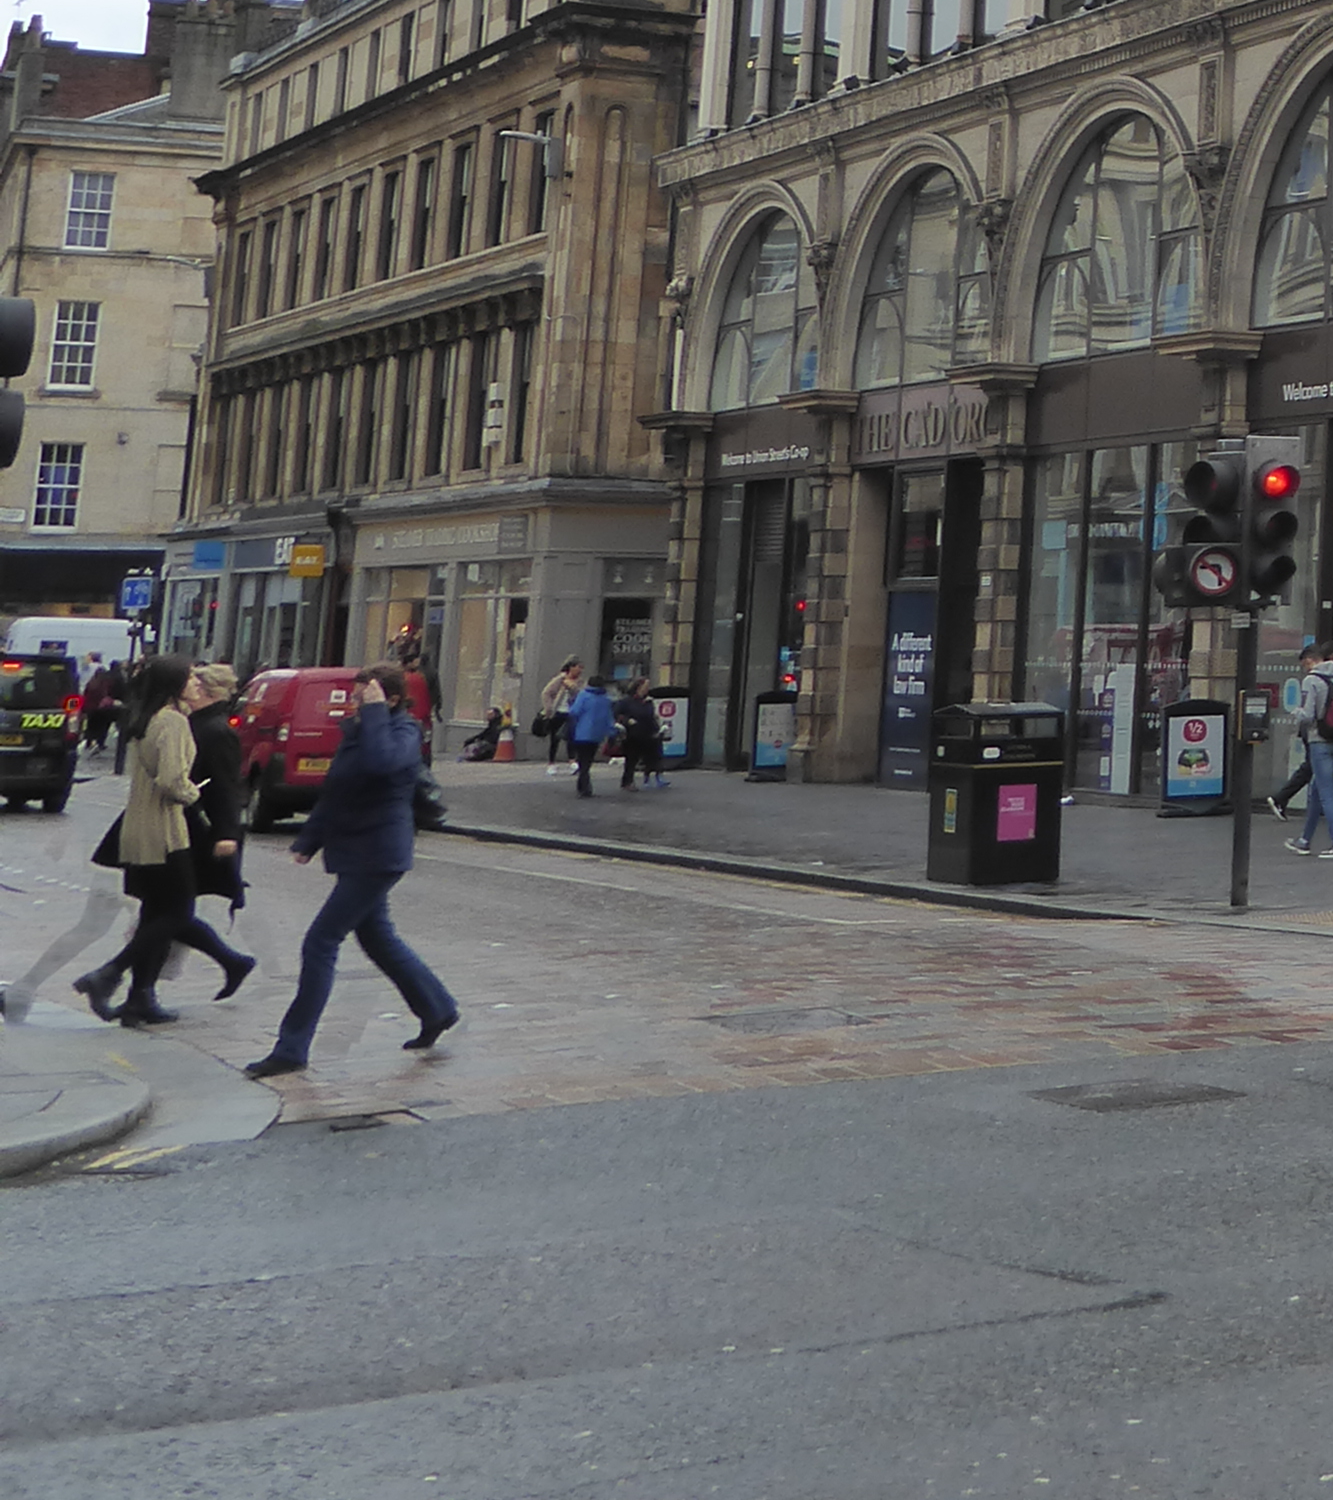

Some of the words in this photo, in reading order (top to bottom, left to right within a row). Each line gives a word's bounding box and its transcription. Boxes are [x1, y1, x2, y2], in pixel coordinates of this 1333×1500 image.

[1282, 381, 1328, 401] Welcome
[891, 632, 900, 651] A
[900, 632, 932, 652] different
[897, 654, 914, 673] kind
[915, 653, 925, 673] of
[21, 714, 65, 728] TAXI
